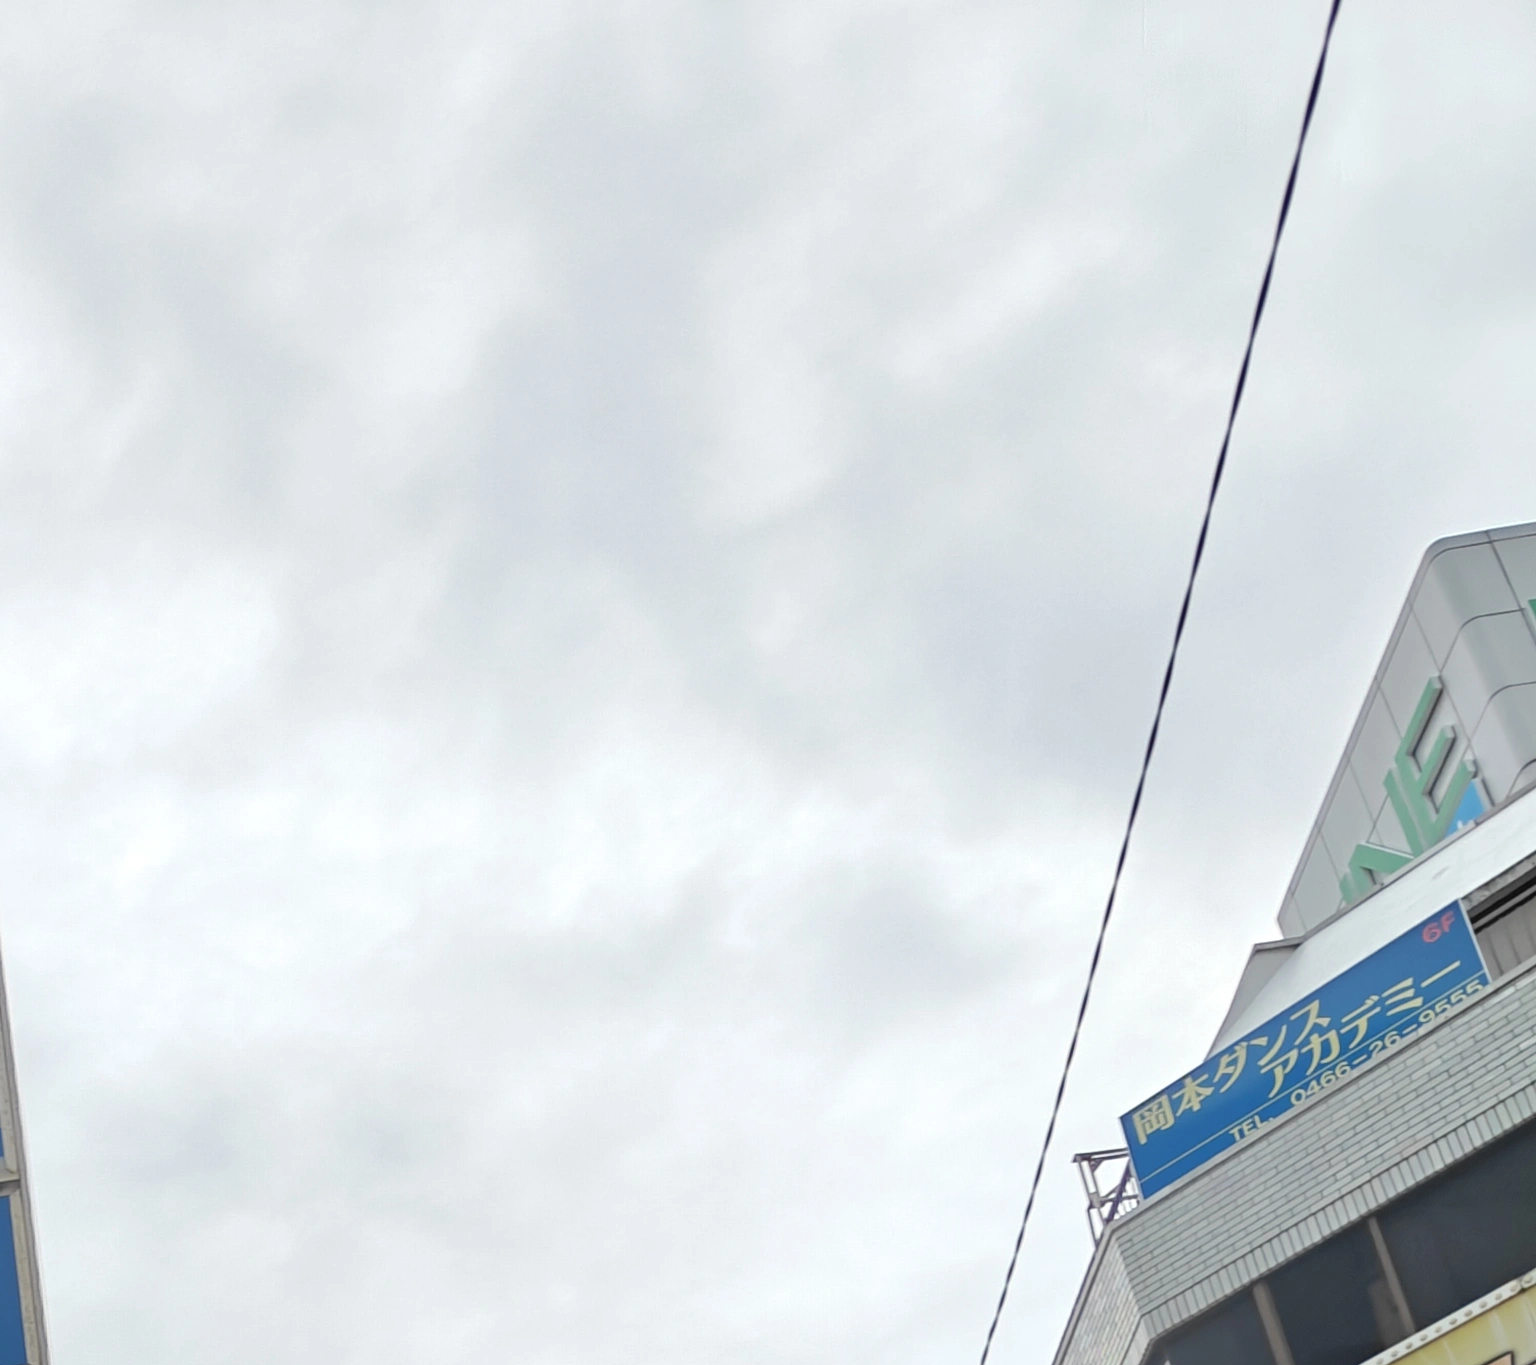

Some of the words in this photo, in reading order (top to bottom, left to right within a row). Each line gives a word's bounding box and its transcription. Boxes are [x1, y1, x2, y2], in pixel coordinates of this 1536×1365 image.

[1422, 910, 1457, 945] 6F
[1131, 998, 1332, 1146] 岡本ダンス
[1259, 959, 1462, 1099] アカデミー
[1290, 978, 1486, 1107] 0466-26-9555
